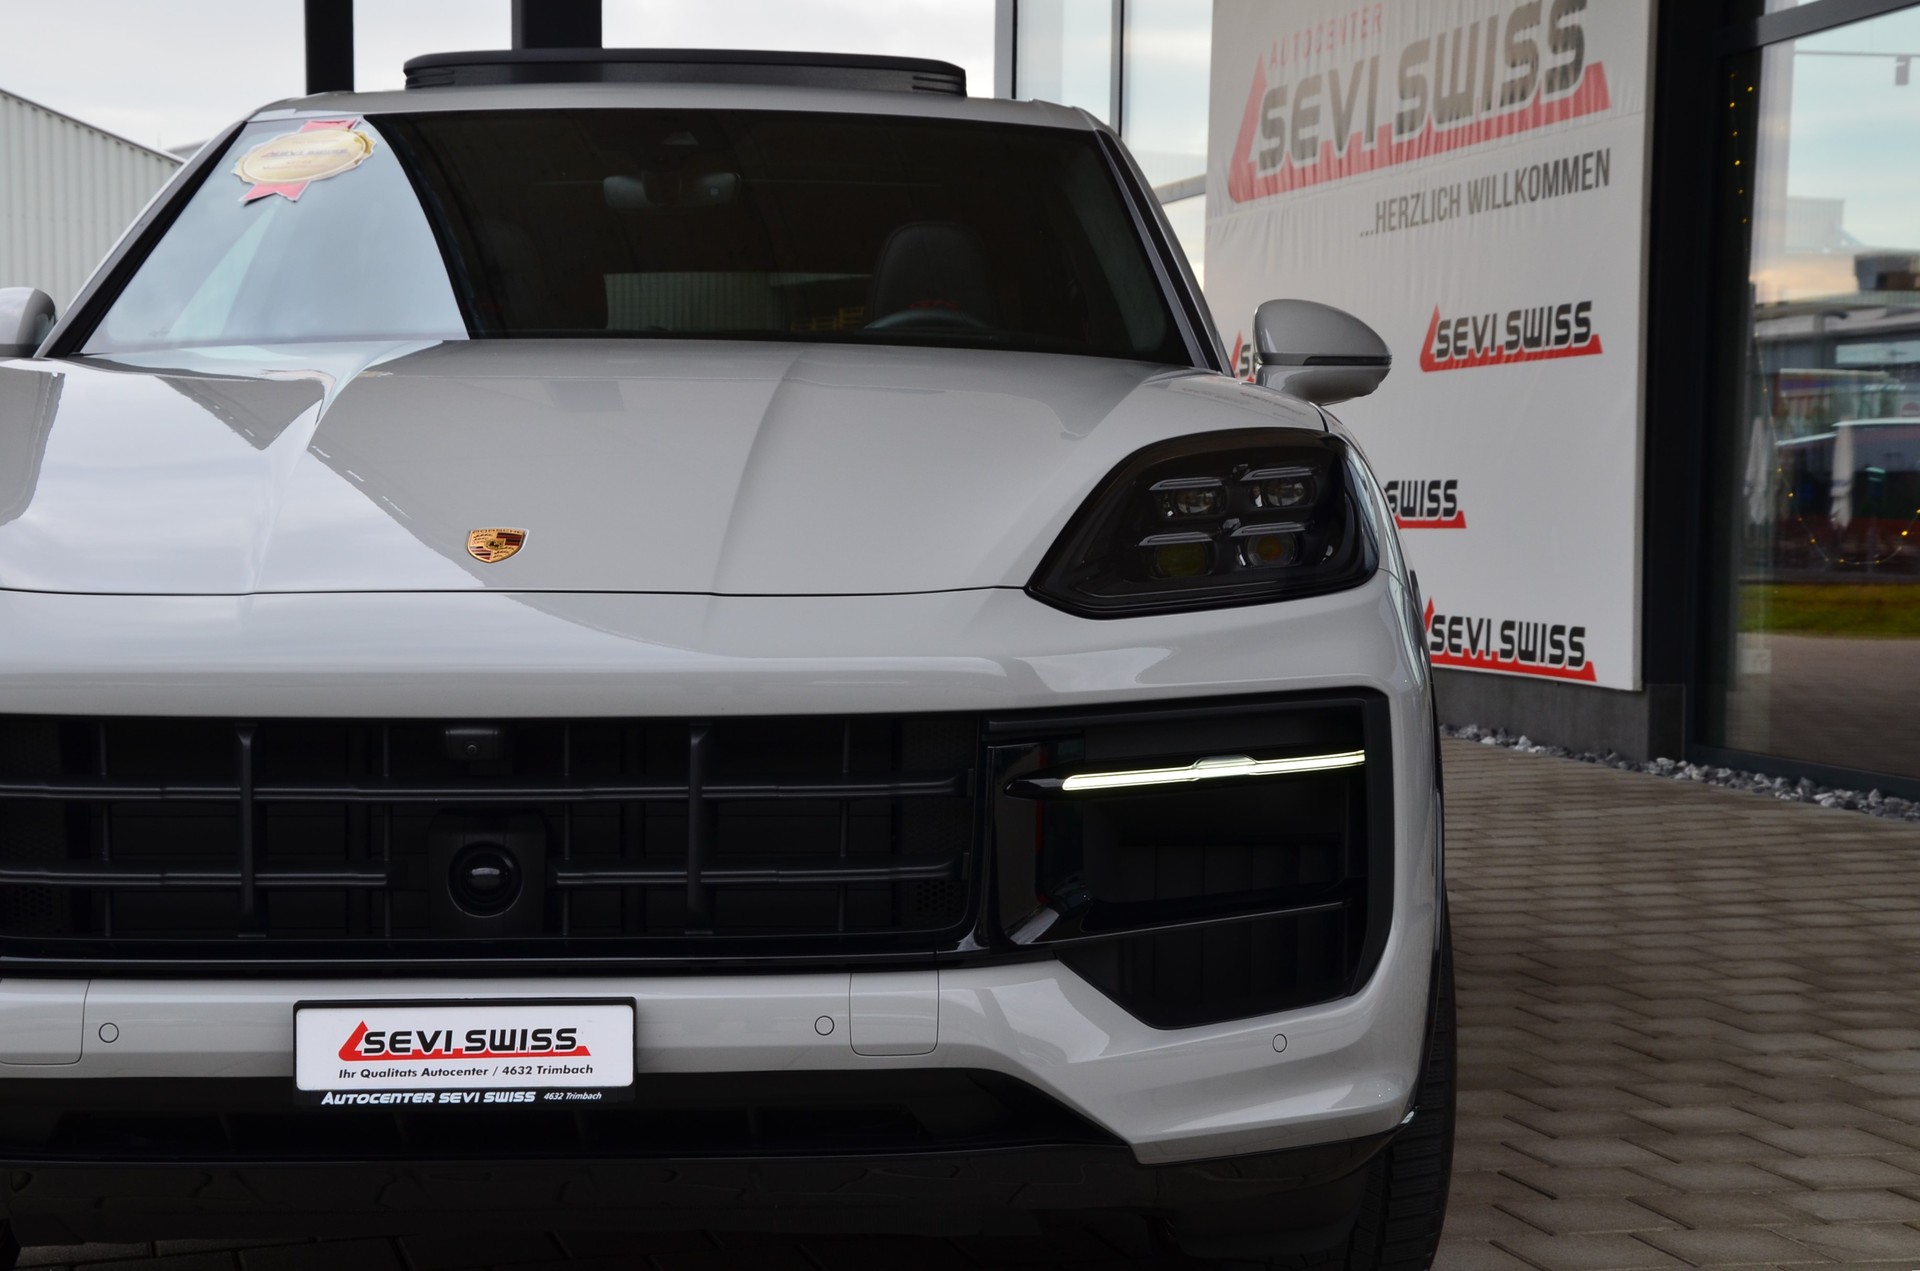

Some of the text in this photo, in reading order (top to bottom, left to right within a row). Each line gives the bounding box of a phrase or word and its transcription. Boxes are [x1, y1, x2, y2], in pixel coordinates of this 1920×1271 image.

[1269, 2, 1383, 67] AUTOCENTER
[1258, 0, 1588, 171] SEVI SWISS
[1468, 148, 1612, 216] WILLKOMMEN
[1436, 301, 1593, 359] SEVI SWISS
[1384, 479, 1458, 518] SWISS
[1430, 614, 1586, 668] SEVI SWISS
[362, 1028, 578, 1054] SEVI SWISS
[321, 1091, 603, 1105] AUTOCENTER SEVI SWISS 4632 Trimbach
[339, 1064, 594, 1079] Ihr Qualitats Autocenter / 4632 Trimbach
